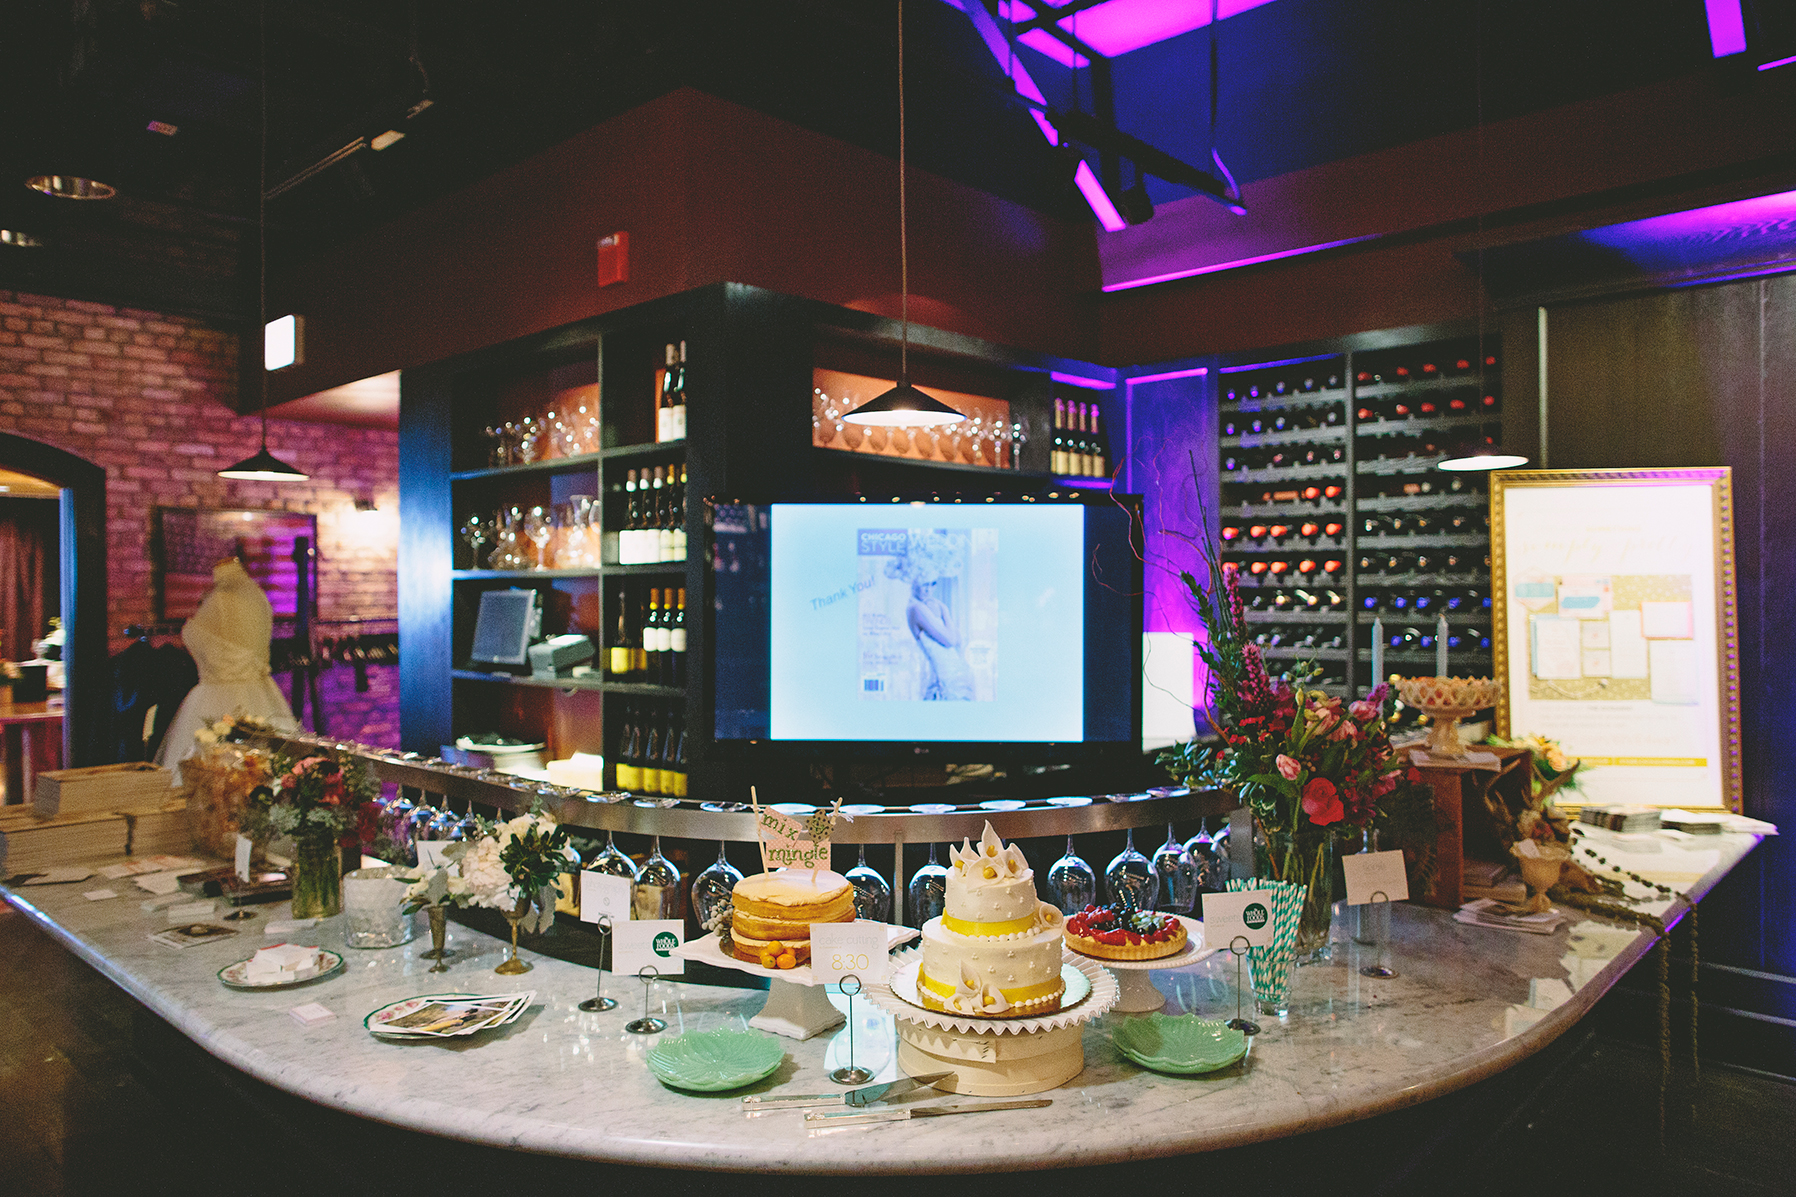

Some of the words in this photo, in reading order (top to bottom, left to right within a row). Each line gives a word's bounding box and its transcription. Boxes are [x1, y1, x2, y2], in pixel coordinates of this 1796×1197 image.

[860, 532, 906, 541] CHICAGO
[861, 540, 906, 553] STYLE
[809, 587, 848, 611] Thank
[848, 575, 875, 594] You!
[761, 813, 799, 841] mix
[768, 843, 828, 868] mingle
[819, 932, 844, 945] cake
[846, 935, 879, 950] cutting
[831, 953, 870, 971] 8:30
